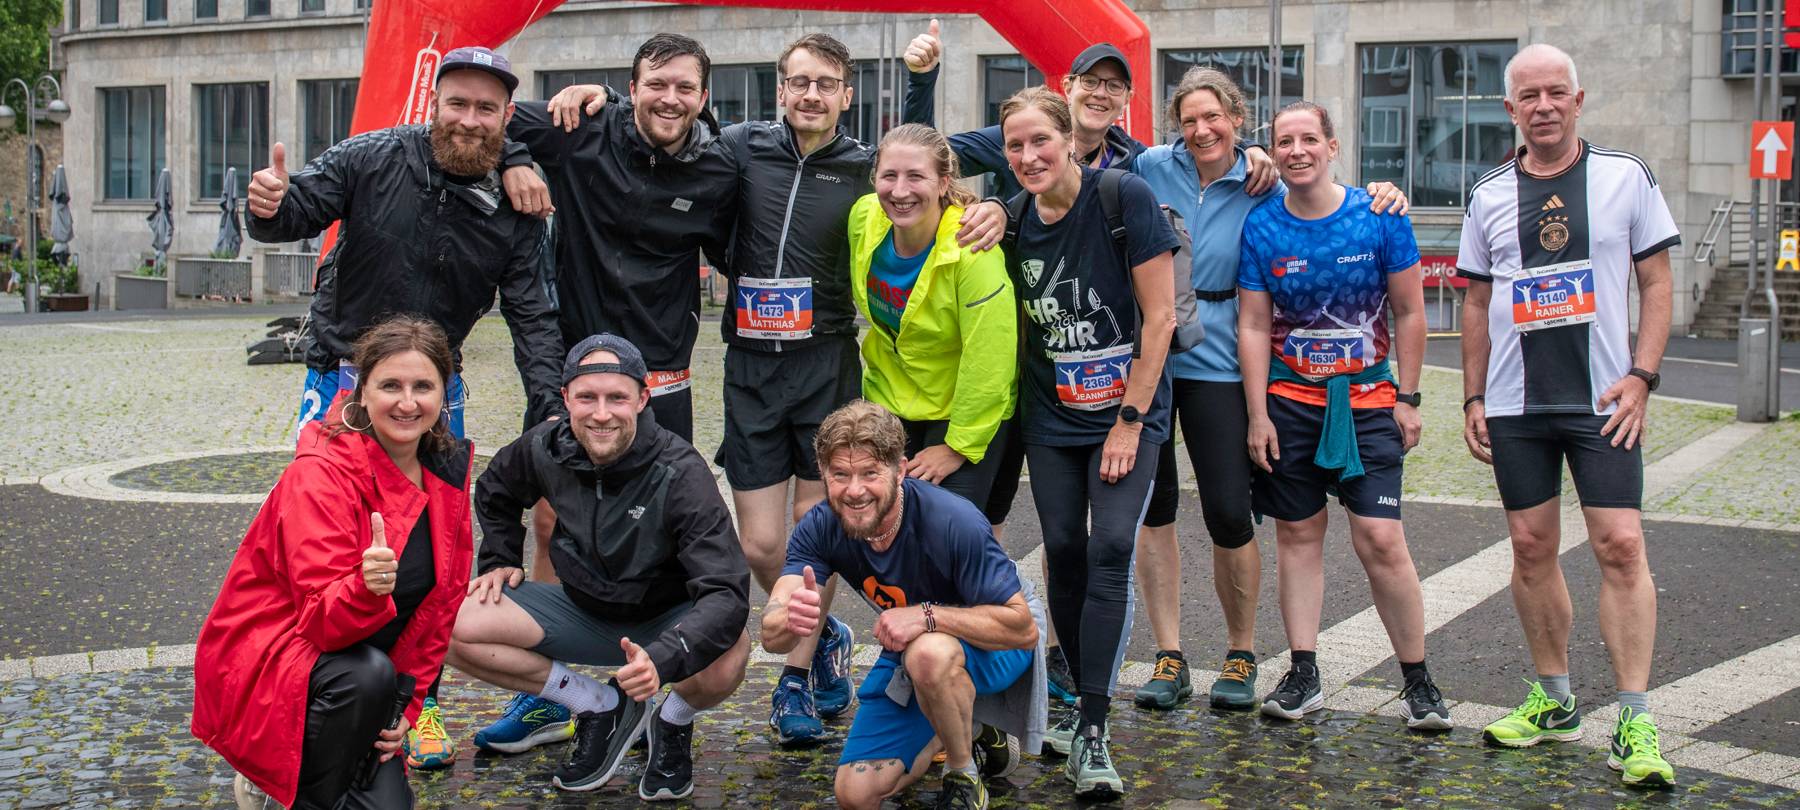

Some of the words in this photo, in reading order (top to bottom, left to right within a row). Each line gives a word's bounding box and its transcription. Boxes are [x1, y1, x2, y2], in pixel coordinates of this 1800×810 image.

[1286, 259, 1308, 268] URBAN
[1337, 253, 1369, 264] CRAFT
[1538, 291, 1567, 305] 3140
[758, 306, 783, 317] 1473
[1535, 304, 1575, 318] RAINER
[750, 320, 795, 329] MATTHIAS
[1310, 353, 1336, 363] 4630
[1310, 366, 1336, 374] LARA
[1084, 376, 1112, 390] 2368
[1075, 387, 1125, 401] JEANNETTE
[1377, 495, 1398, 507] JAKO
